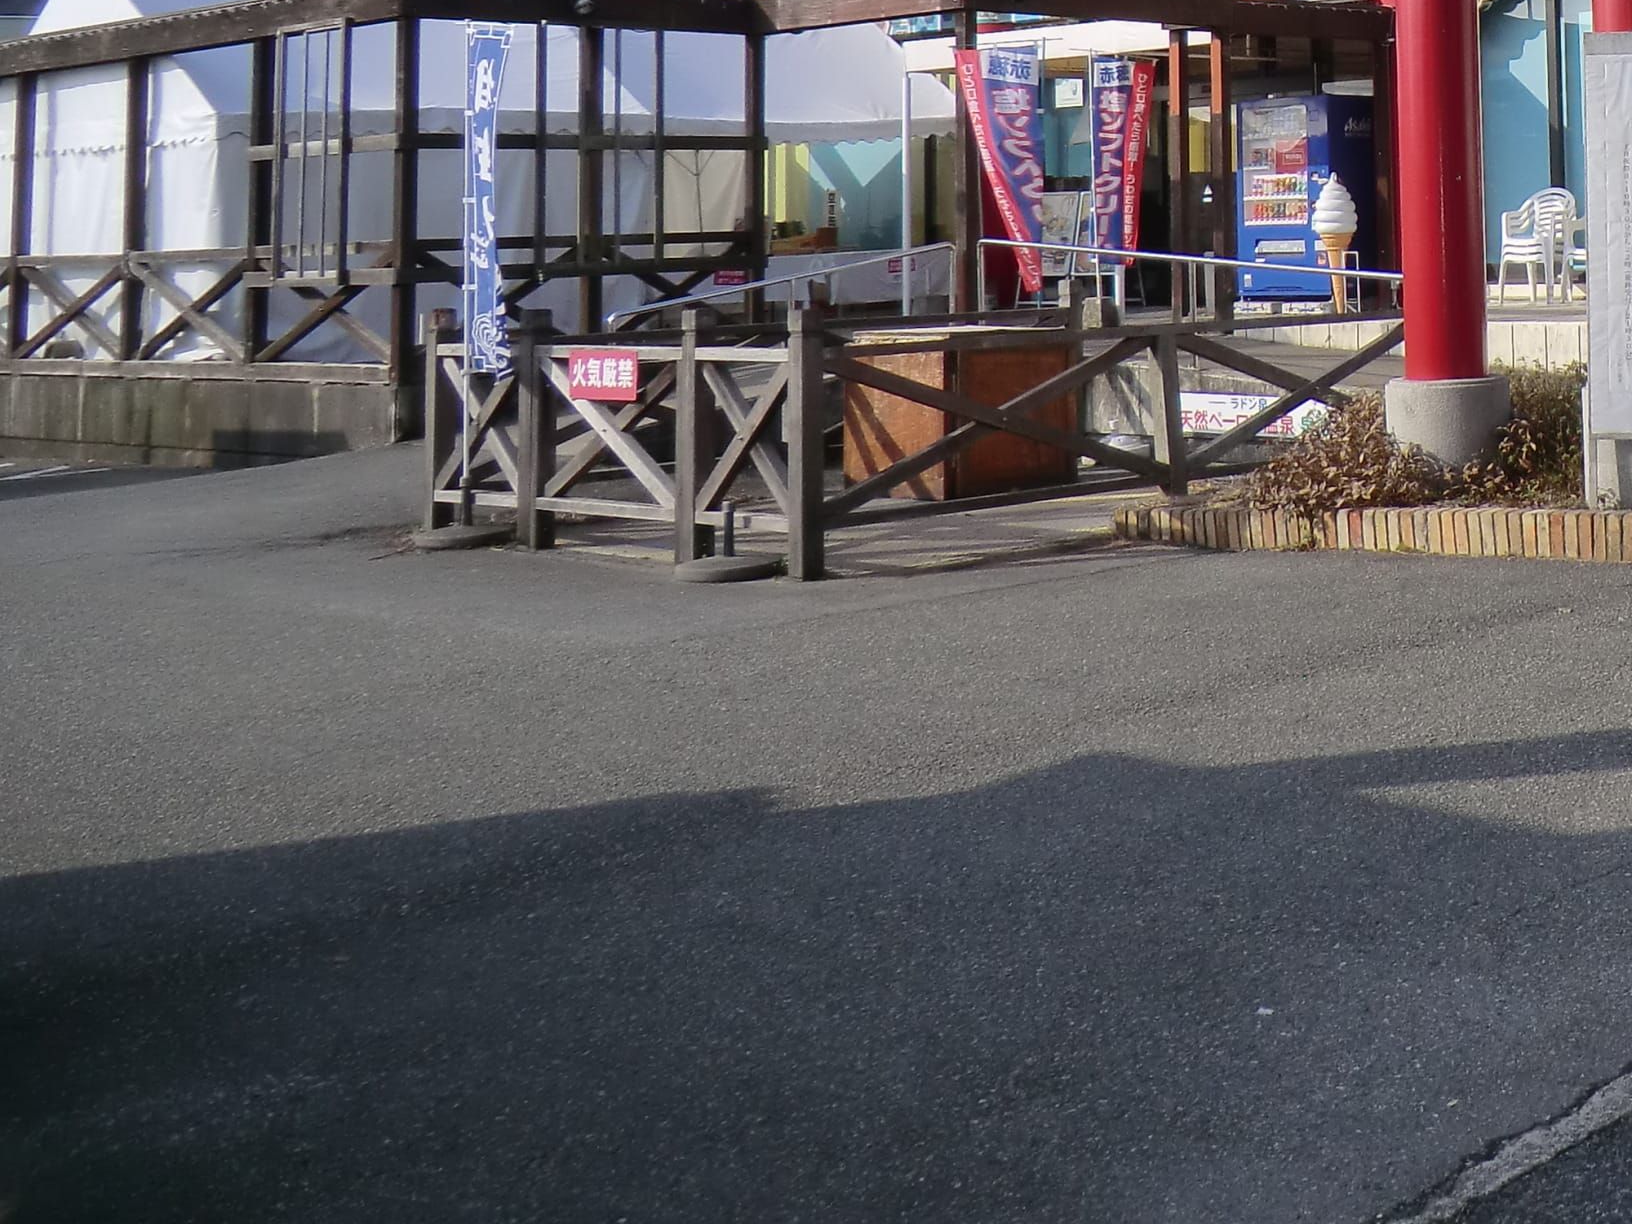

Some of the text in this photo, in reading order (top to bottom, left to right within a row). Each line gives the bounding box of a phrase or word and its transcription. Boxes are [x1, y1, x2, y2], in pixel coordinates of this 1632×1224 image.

[572, 358, 633, 389] 火気厳禁
[1230, 398, 1268, 410] ラドン泉
[1181, 410, 1295, 435] 天然ペーロ温泉
